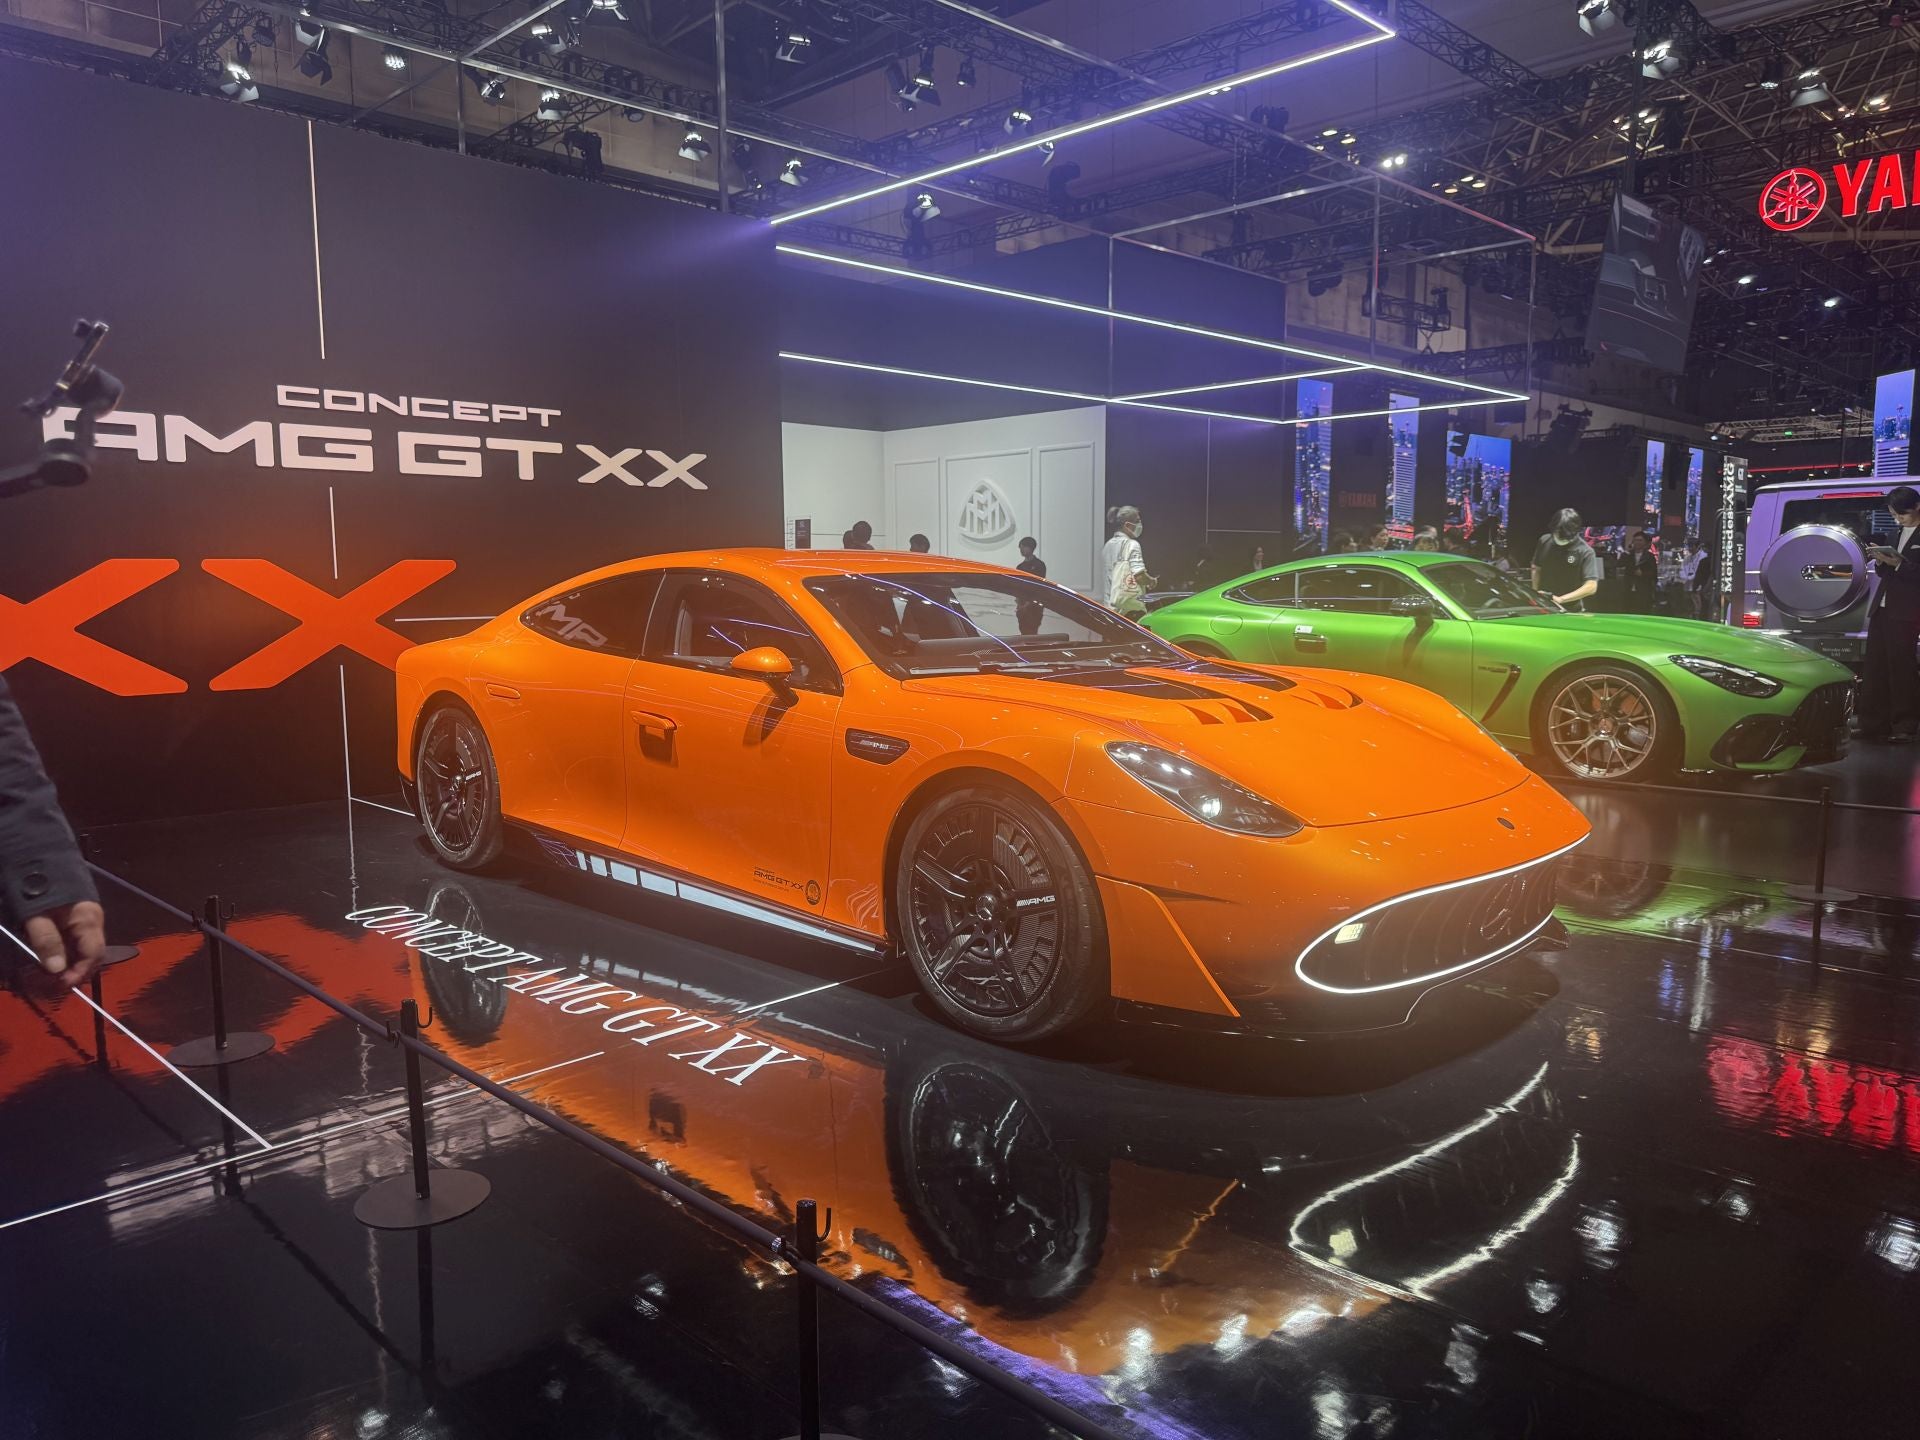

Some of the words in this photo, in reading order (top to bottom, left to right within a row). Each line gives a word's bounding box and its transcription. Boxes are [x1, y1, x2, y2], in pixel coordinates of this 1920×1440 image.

[1833, 148, 1920, 217] YA
[277, 385, 561, 427] CONCEPT
[43, 406, 374, 473] AMG
[398, 431, 563, 481] GT
[576, 444, 708, 491] XX
[1723, 462, 1735, 593] Mercedes-AMG
[754, 870, 775, 881] AMG
[776, 876, 790, 886] GT
[791, 881, 804, 892] XX
[1028, 895, 1056, 905] AMG
[344, 905, 542, 982] CONCEPT
[503, 966, 643, 1016] AMG
[602, 1006, 727, 1047] GT
[668, 1032, 807, 1087] XX
